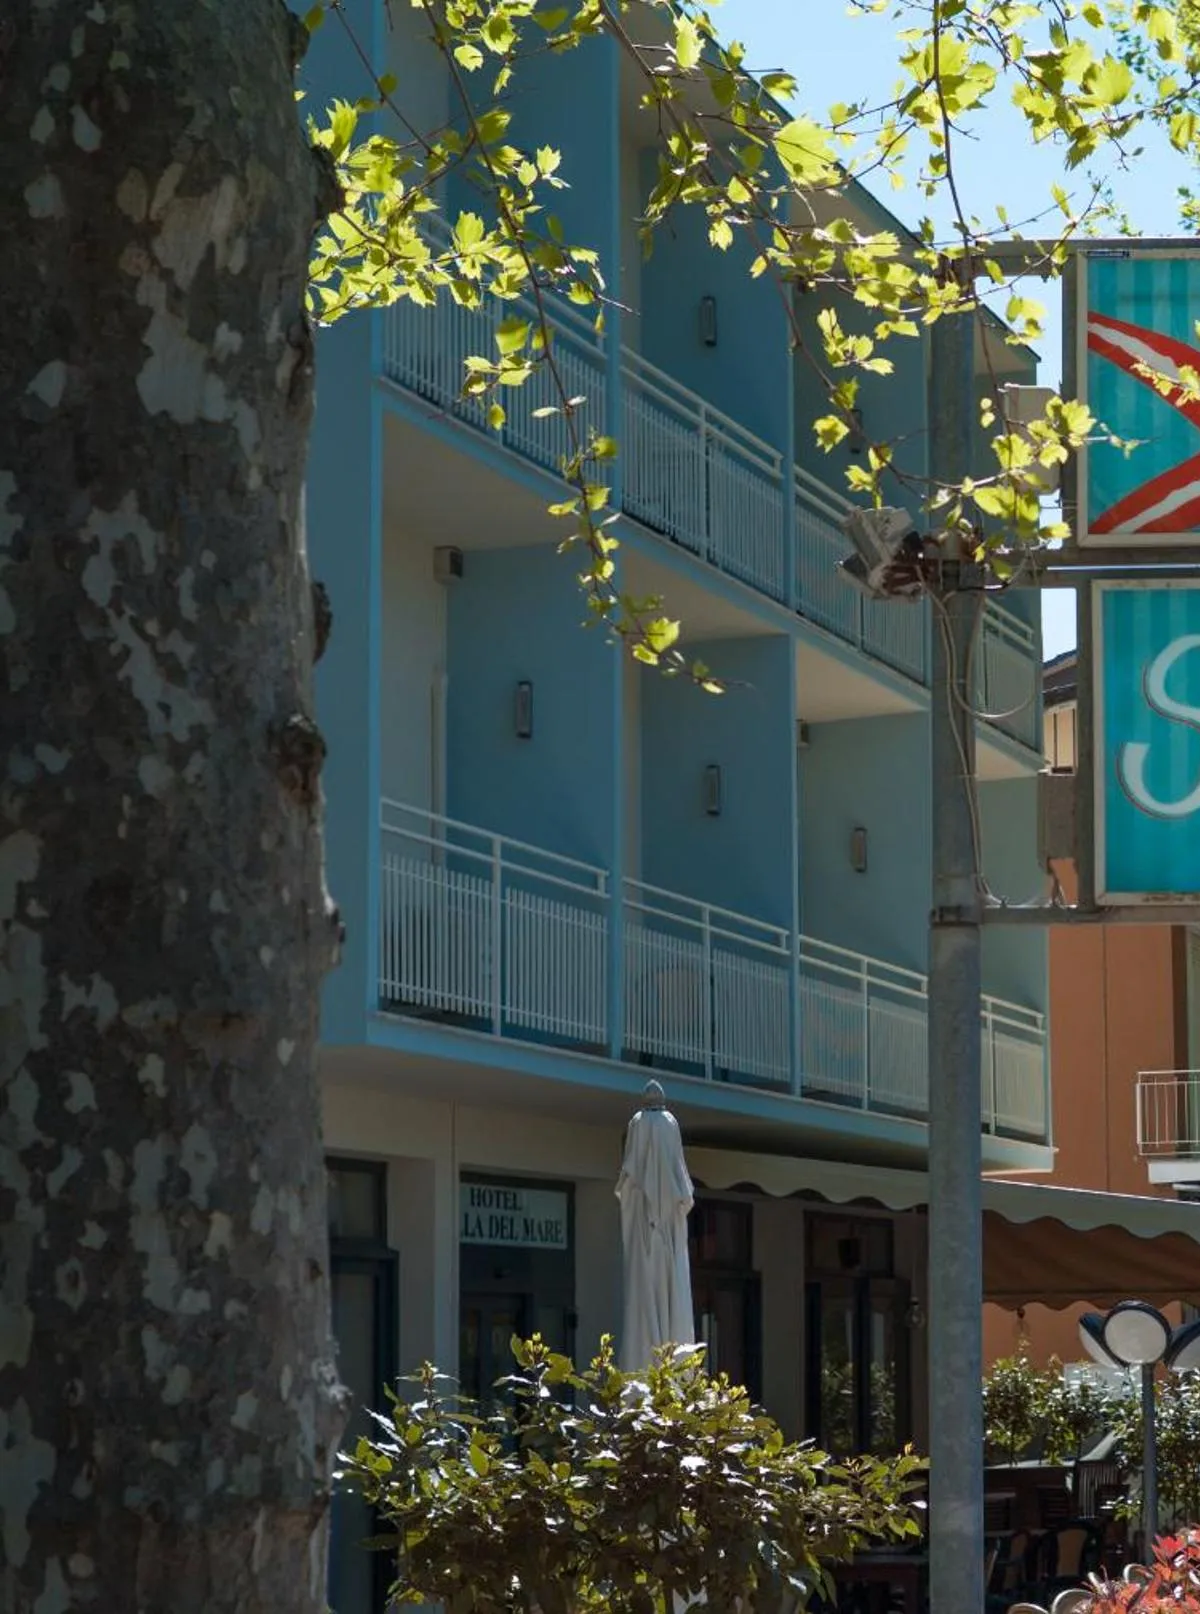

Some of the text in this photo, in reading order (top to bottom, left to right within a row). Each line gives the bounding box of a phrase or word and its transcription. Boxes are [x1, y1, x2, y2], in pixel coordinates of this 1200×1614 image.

[470, 1186, 522, 1211] HOTEL
[460, 1212, 564, 1244] LA DEL MARE
